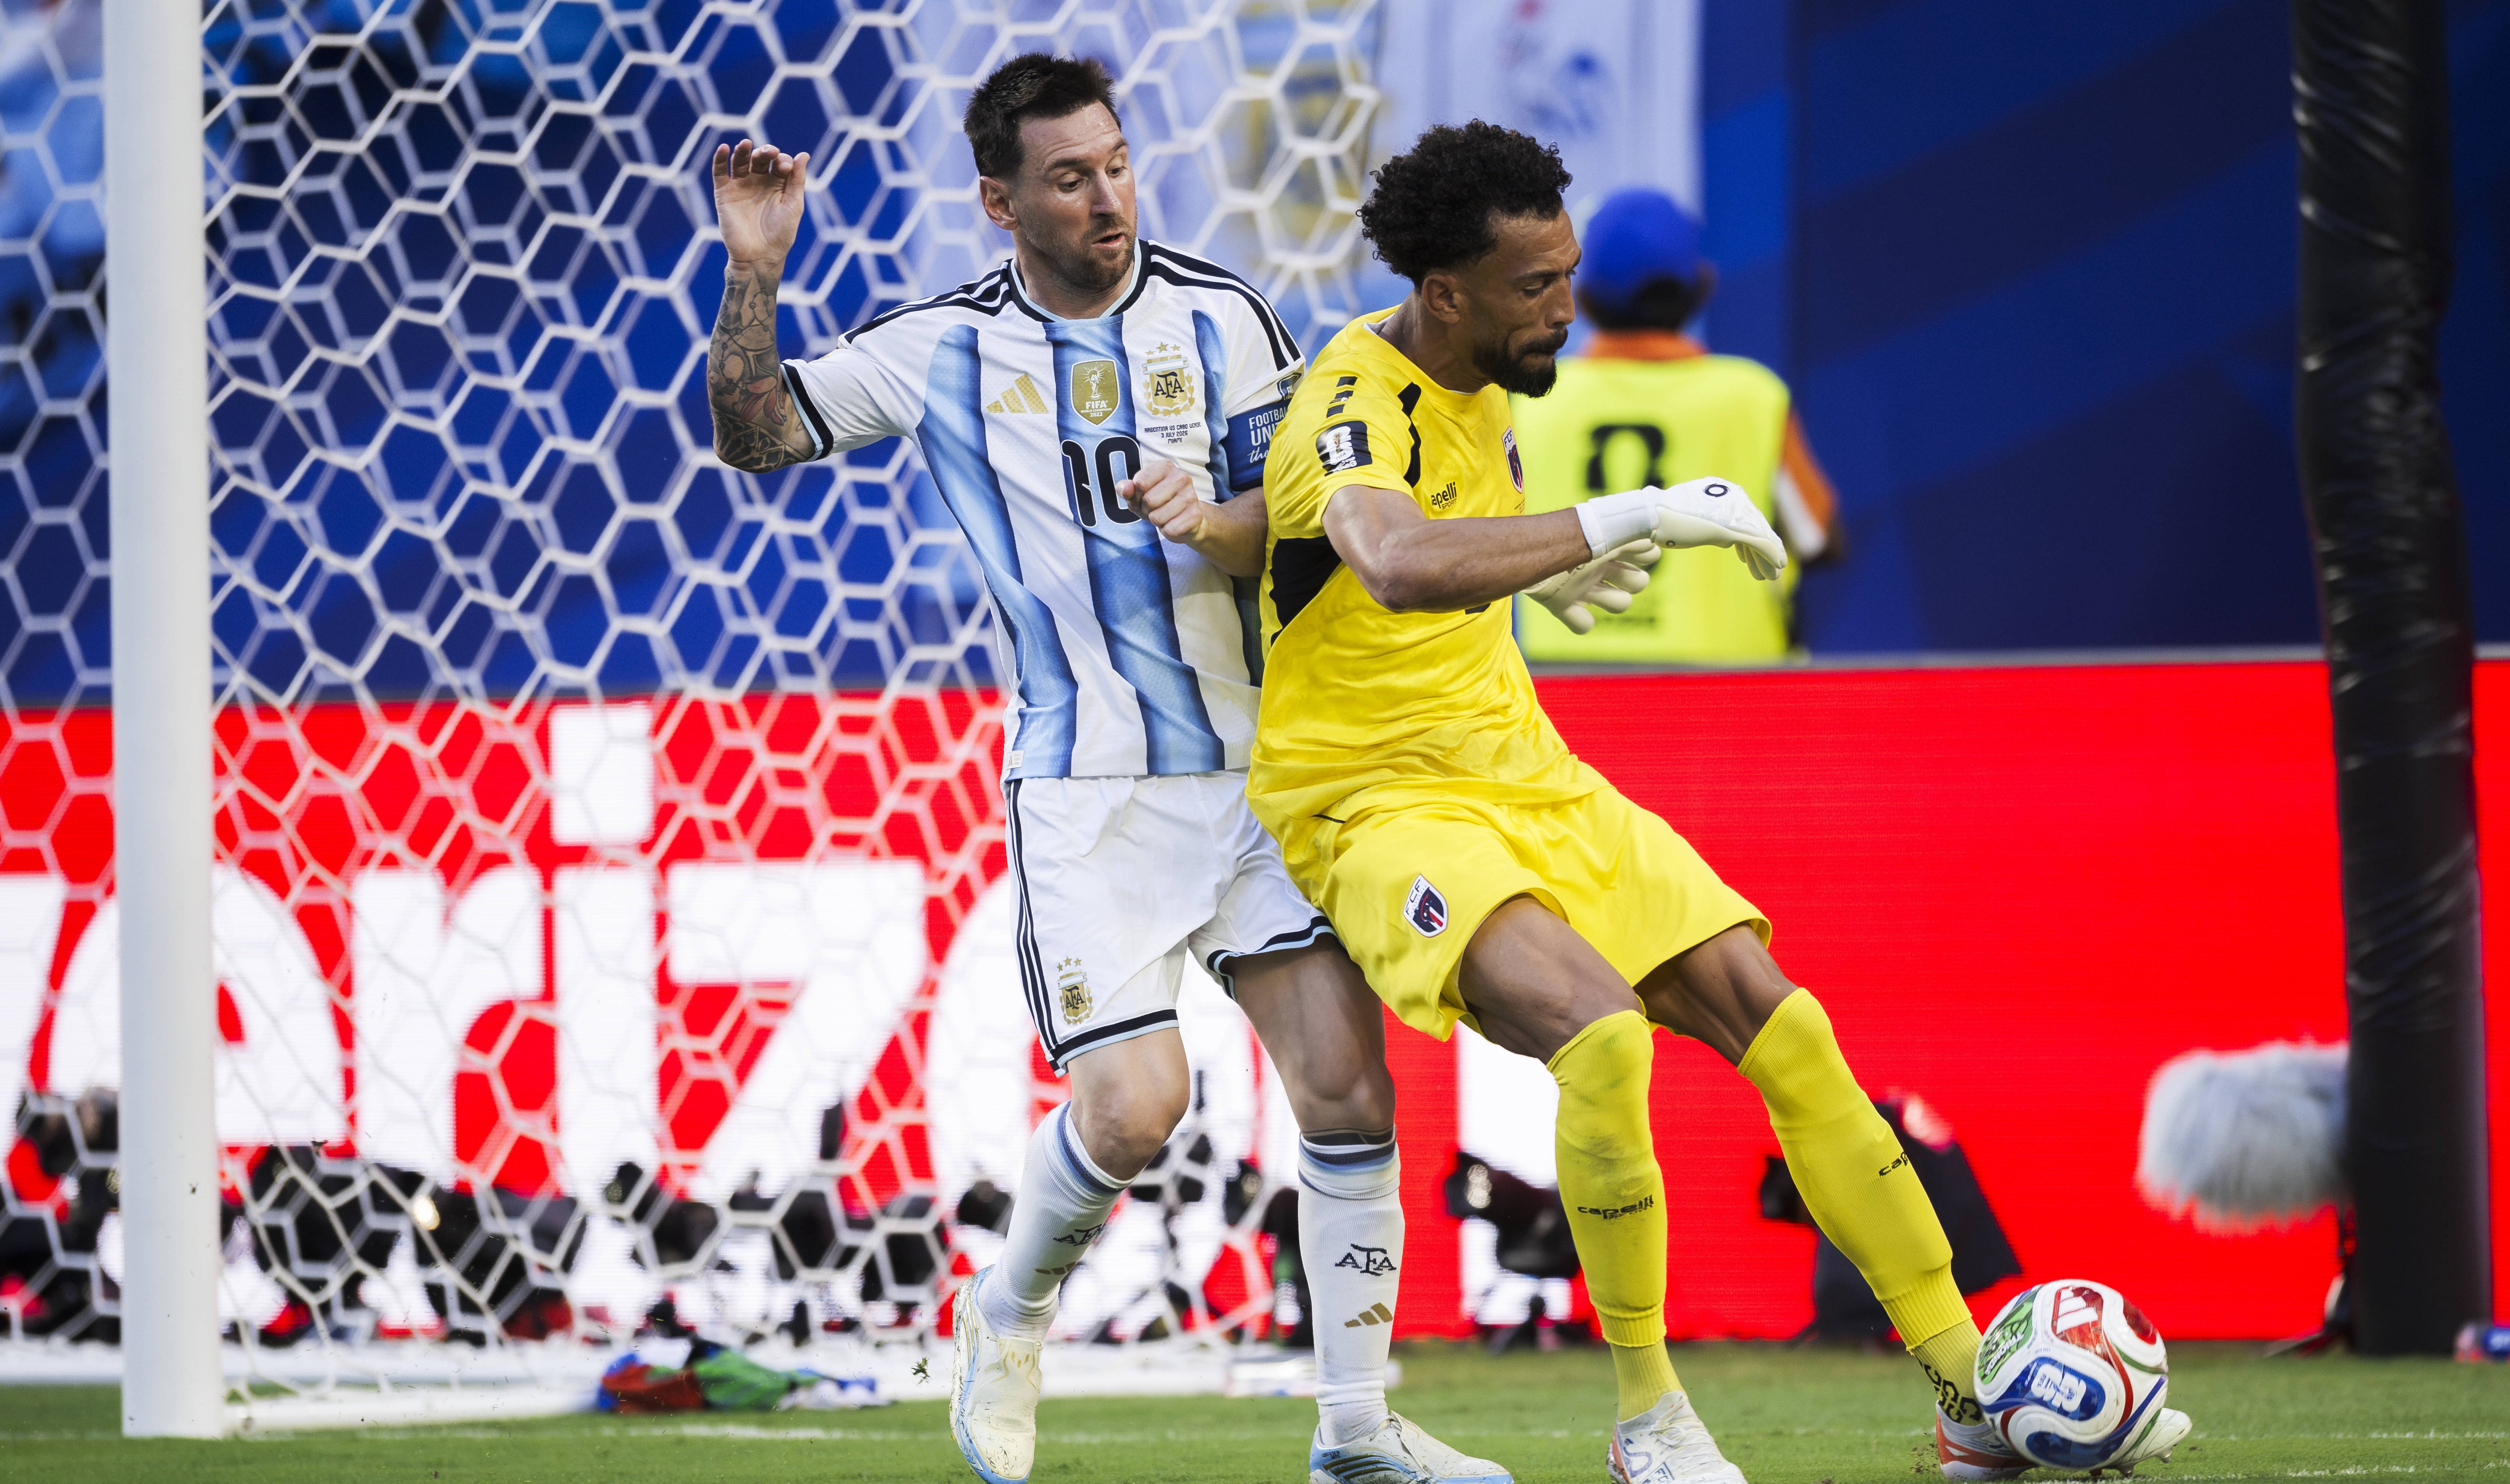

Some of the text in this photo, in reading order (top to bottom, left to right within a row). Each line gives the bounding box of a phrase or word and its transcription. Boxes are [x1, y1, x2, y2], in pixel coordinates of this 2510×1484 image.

[1155, 371, 1184, 398] AFA
[1085, 400, 1107, 409] FIFA
[1250, 422, 1279, 446] UNI
[1504, 430, 1512, 448] FCF
[1061, 436, 1143, 528] 10
[1431, 481, 1457, 509] apelli
[1441, 498, 1457, 510] SPORT
[1405, 879, 1420, 915] FCF
[1065, 986, 1084, 1009] AFA
[1334, 1243, 1397, 1276] AFA
